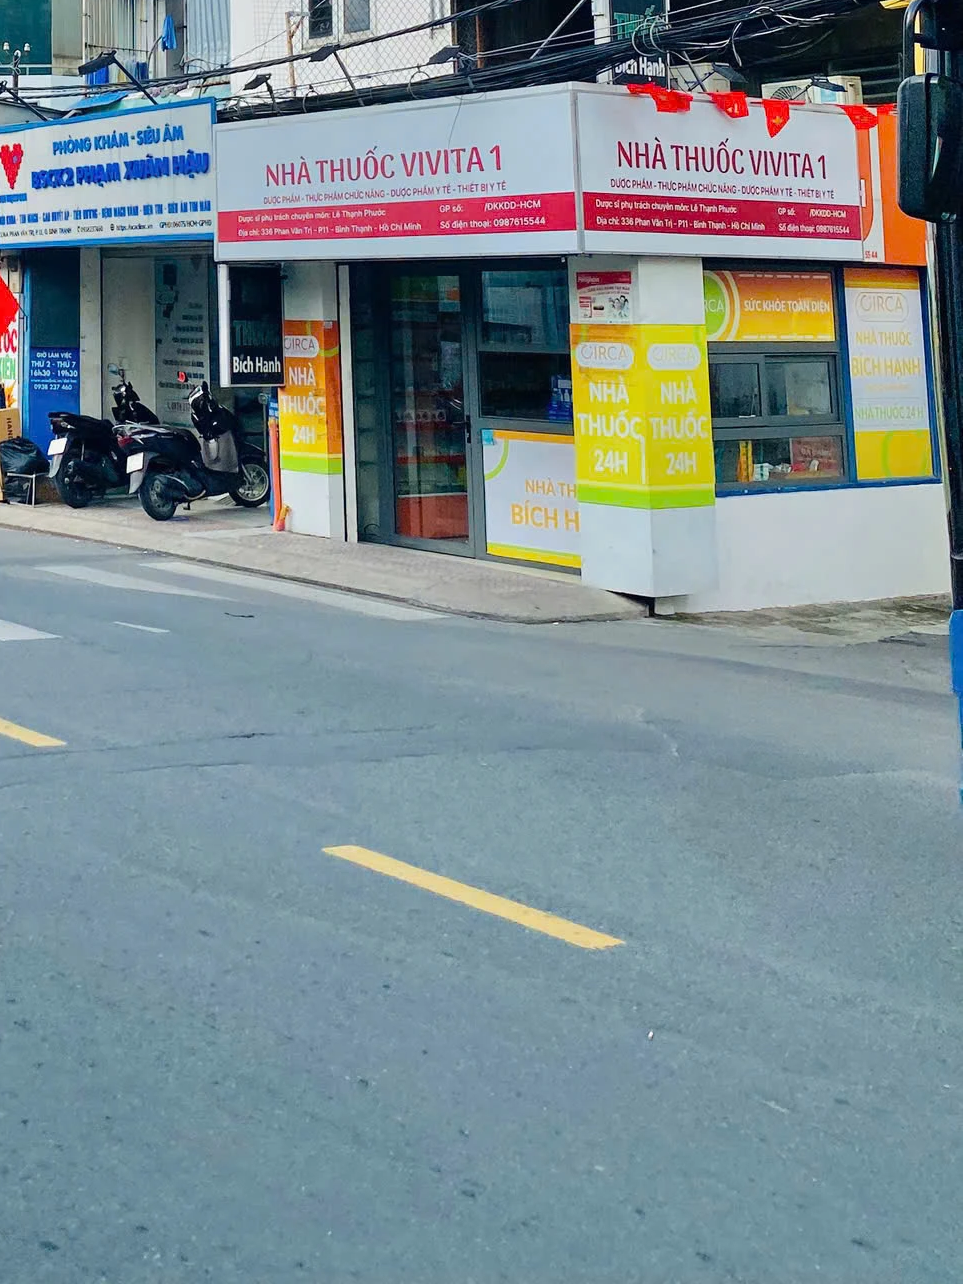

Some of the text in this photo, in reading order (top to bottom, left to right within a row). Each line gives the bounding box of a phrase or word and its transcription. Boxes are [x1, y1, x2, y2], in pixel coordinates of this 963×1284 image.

[52, 122, 184, 156] PHÒNG KHÁM SIÊU ÂM
[75, 162, 121, 188] PHẠM
[123, 153, 170, 181] XUÂN
[172, 148, 210, 179] HẬU
[266, 144, 502, 187] NHÀ THUỐC VIVITA 1
[618, 137, 827, 179] NHÀ THUỐC VIVITA 1
[263, 180, 507, 205] DƯỢC PHẨM THỰC PHẨM CHỨC NĂNG DƯỢC PHẨM Y TẾ THIẾT BỊ Y TẾ
[610, 178, 834, 199] DƯỢC PHẨM THỰC PHẨM CHỨC NĂNG DƯỢC PHẨM Y TẾ THIẾT TẾ
[439, 204, 451, 213] GP
[777, 207, 786, 215] GP
[274, 227, 290, 236] Phan
[318, 225, 329, 233] P11
[351, 224, 372, 234] Thạnh
[404, 222, 421, 230] Minh
[439, 220, 450, 229] Số
[493, 216, 546, 227] 0987615544
[634, 218, 650, 226] Phan
[678, 220, 688, 228] P11
[751, 222, 766, 231] Minh
[871, 250, 878, 258] 44
[744, 297, 762, 312] SỨC
[787, 296, 811, 312] TOÀN
[811, 298, 830, 314] DIỆN
[855, 327, 912, 346] NHÀ THUỐC
[30, 368, 78, 378] 16h30 19h30
[289, 363, 317, 387] NHÀ
[851, 353, 922, 380] BÍCH HẠNH
[589, 376, 629, 404] NHÀ
[661, 376, 697, 404] NHÀ
[280, 391, 325, 416] THUỐC
[855, 403, 924, 421] NHÀ THUỐC 24 H
[292, 425, 315, 444] 24H
[578, 409, 642, 438] THUỐC
[649, 409, 708, 439] THUỐC
[594, 449, 628, 475] 24H
[666, 452, 697, 475] 24H
[525, 477, 556, 496] NHÀ
[511, 500, 558, 529] BÍCH
